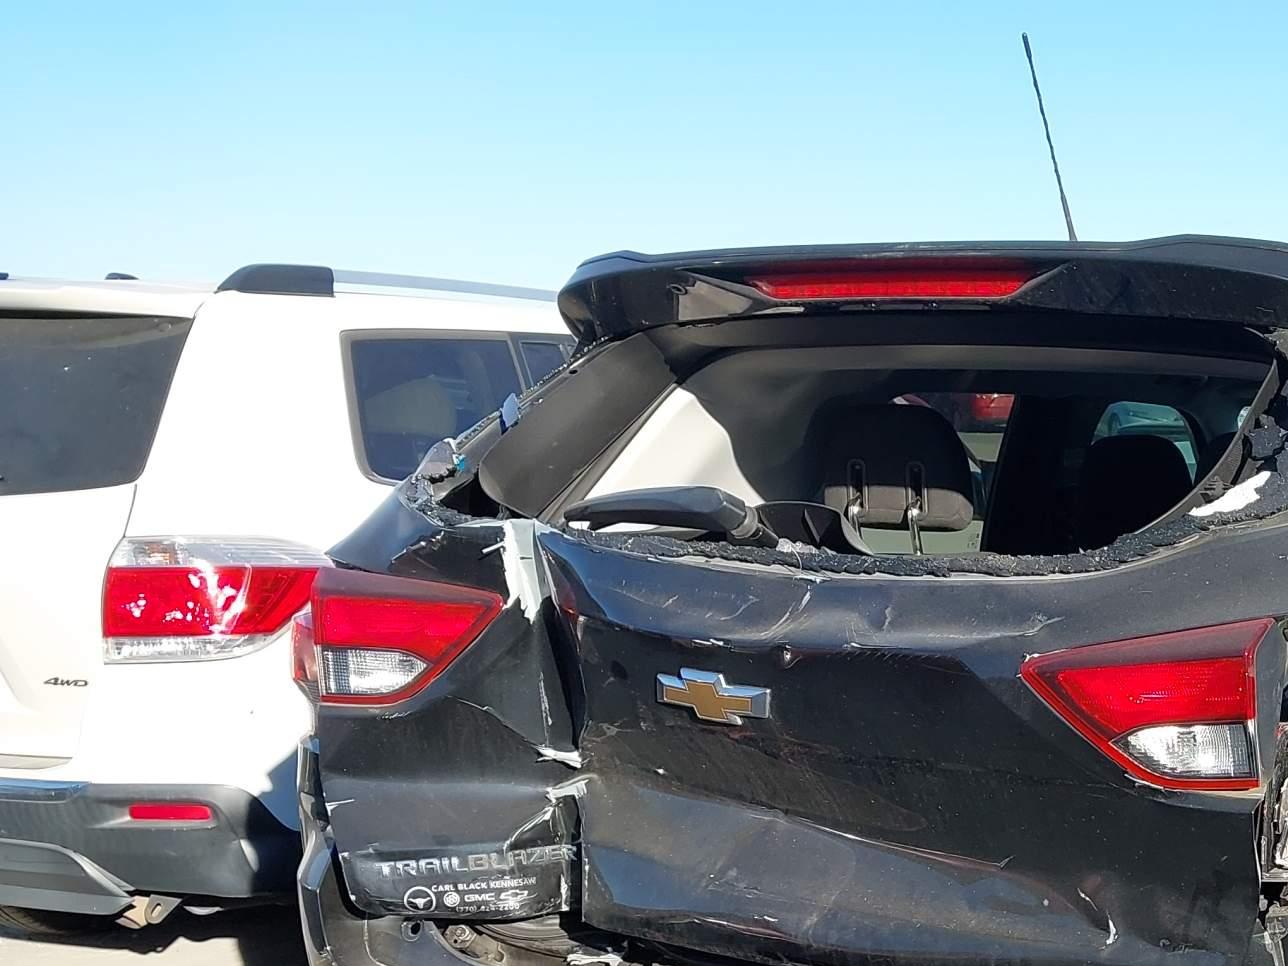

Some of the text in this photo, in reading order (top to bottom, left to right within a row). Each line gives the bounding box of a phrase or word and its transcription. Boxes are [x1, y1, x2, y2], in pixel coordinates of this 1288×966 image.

[43, 676, 89, 687] 4WD
[375, 844, 577, 877] TRAILBLAZER
[431, 877, 537, 893] CARL BLACK KENNESAW
[464, 893, 496, 902] GMC
[455, 905, 478, 913] (770)
